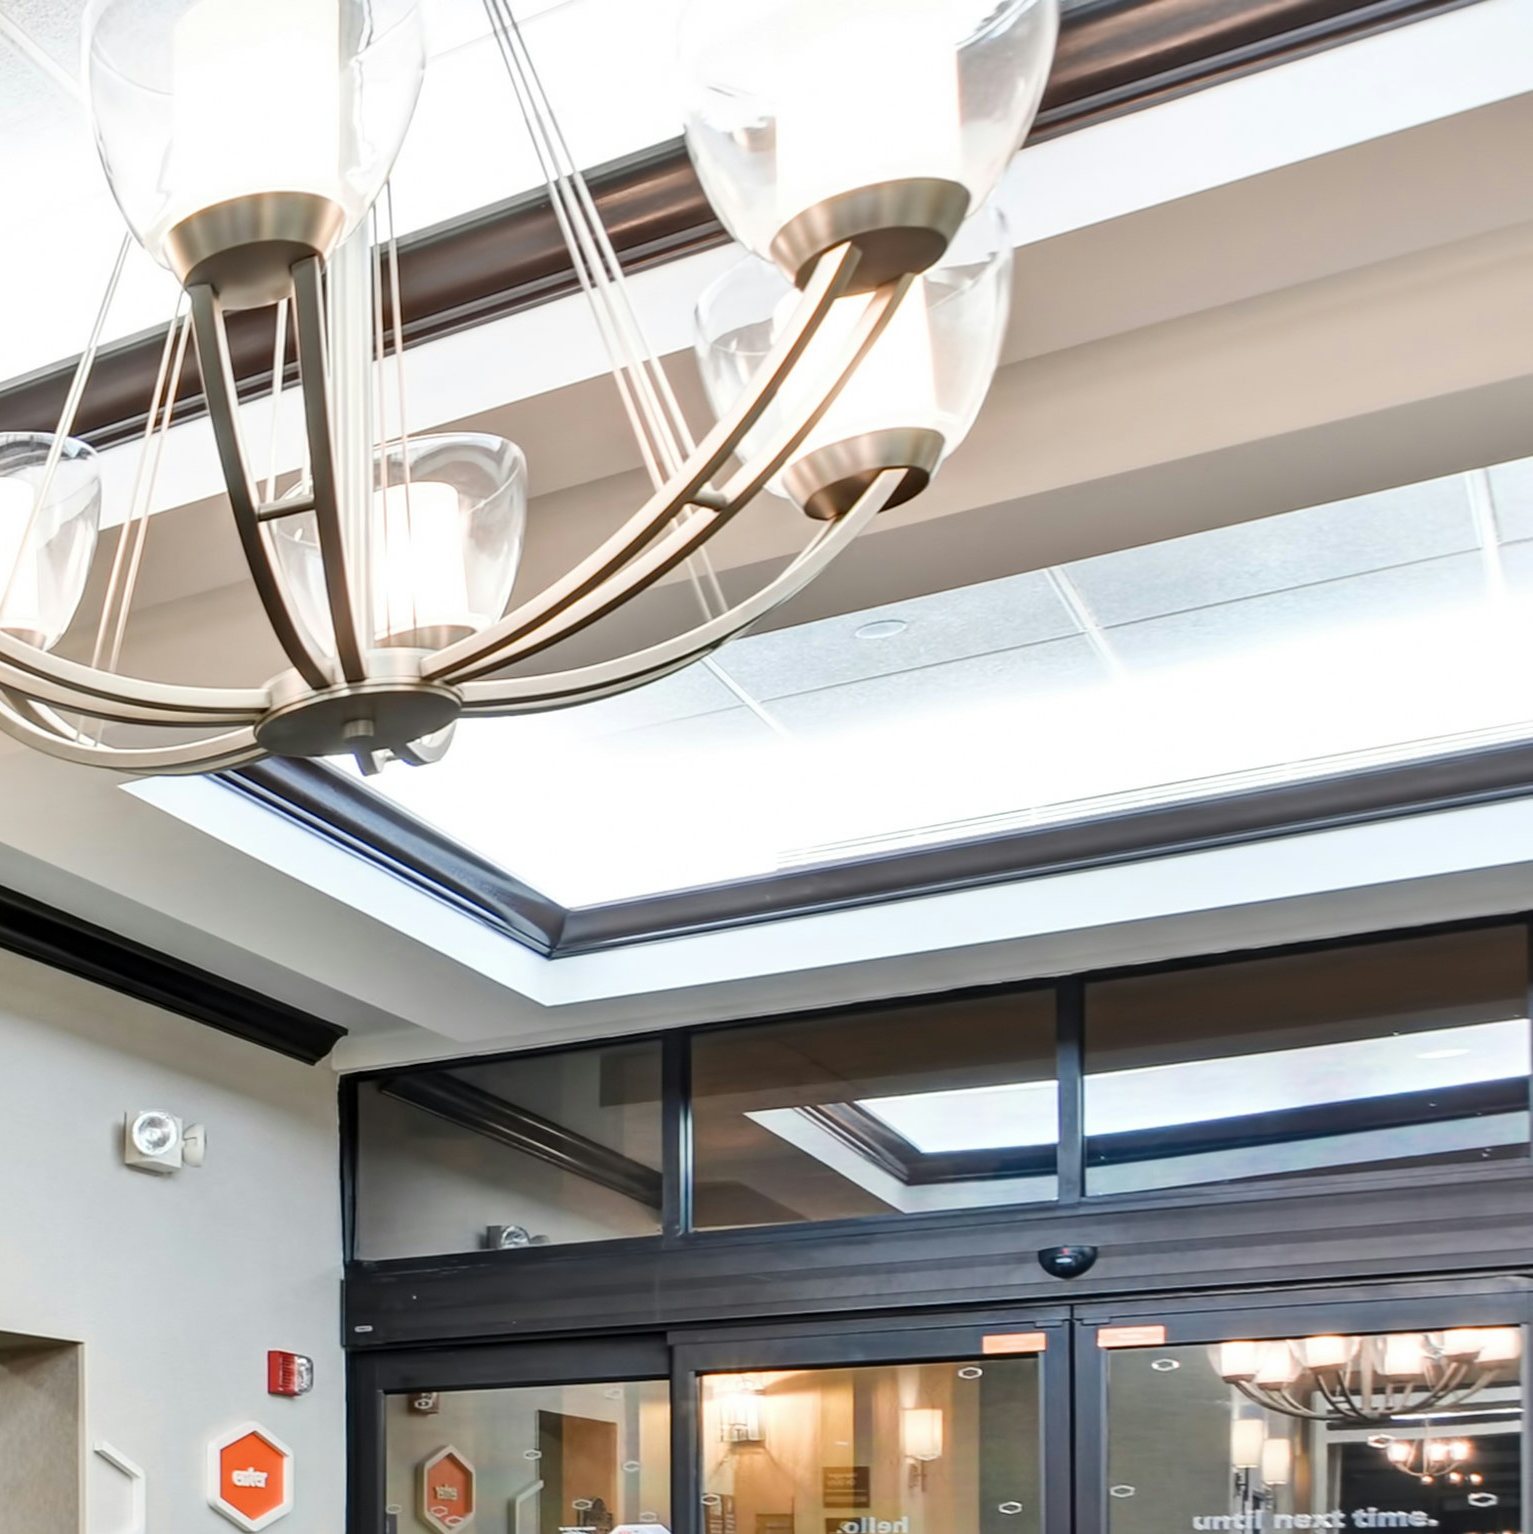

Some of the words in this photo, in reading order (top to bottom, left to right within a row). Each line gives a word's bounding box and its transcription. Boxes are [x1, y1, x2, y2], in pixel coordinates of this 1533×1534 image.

[1192, 1508, 1267, 1531] until
[1273, 1509, 1346, 1530] next
[1351, 1506, 1440, 1529] time.
